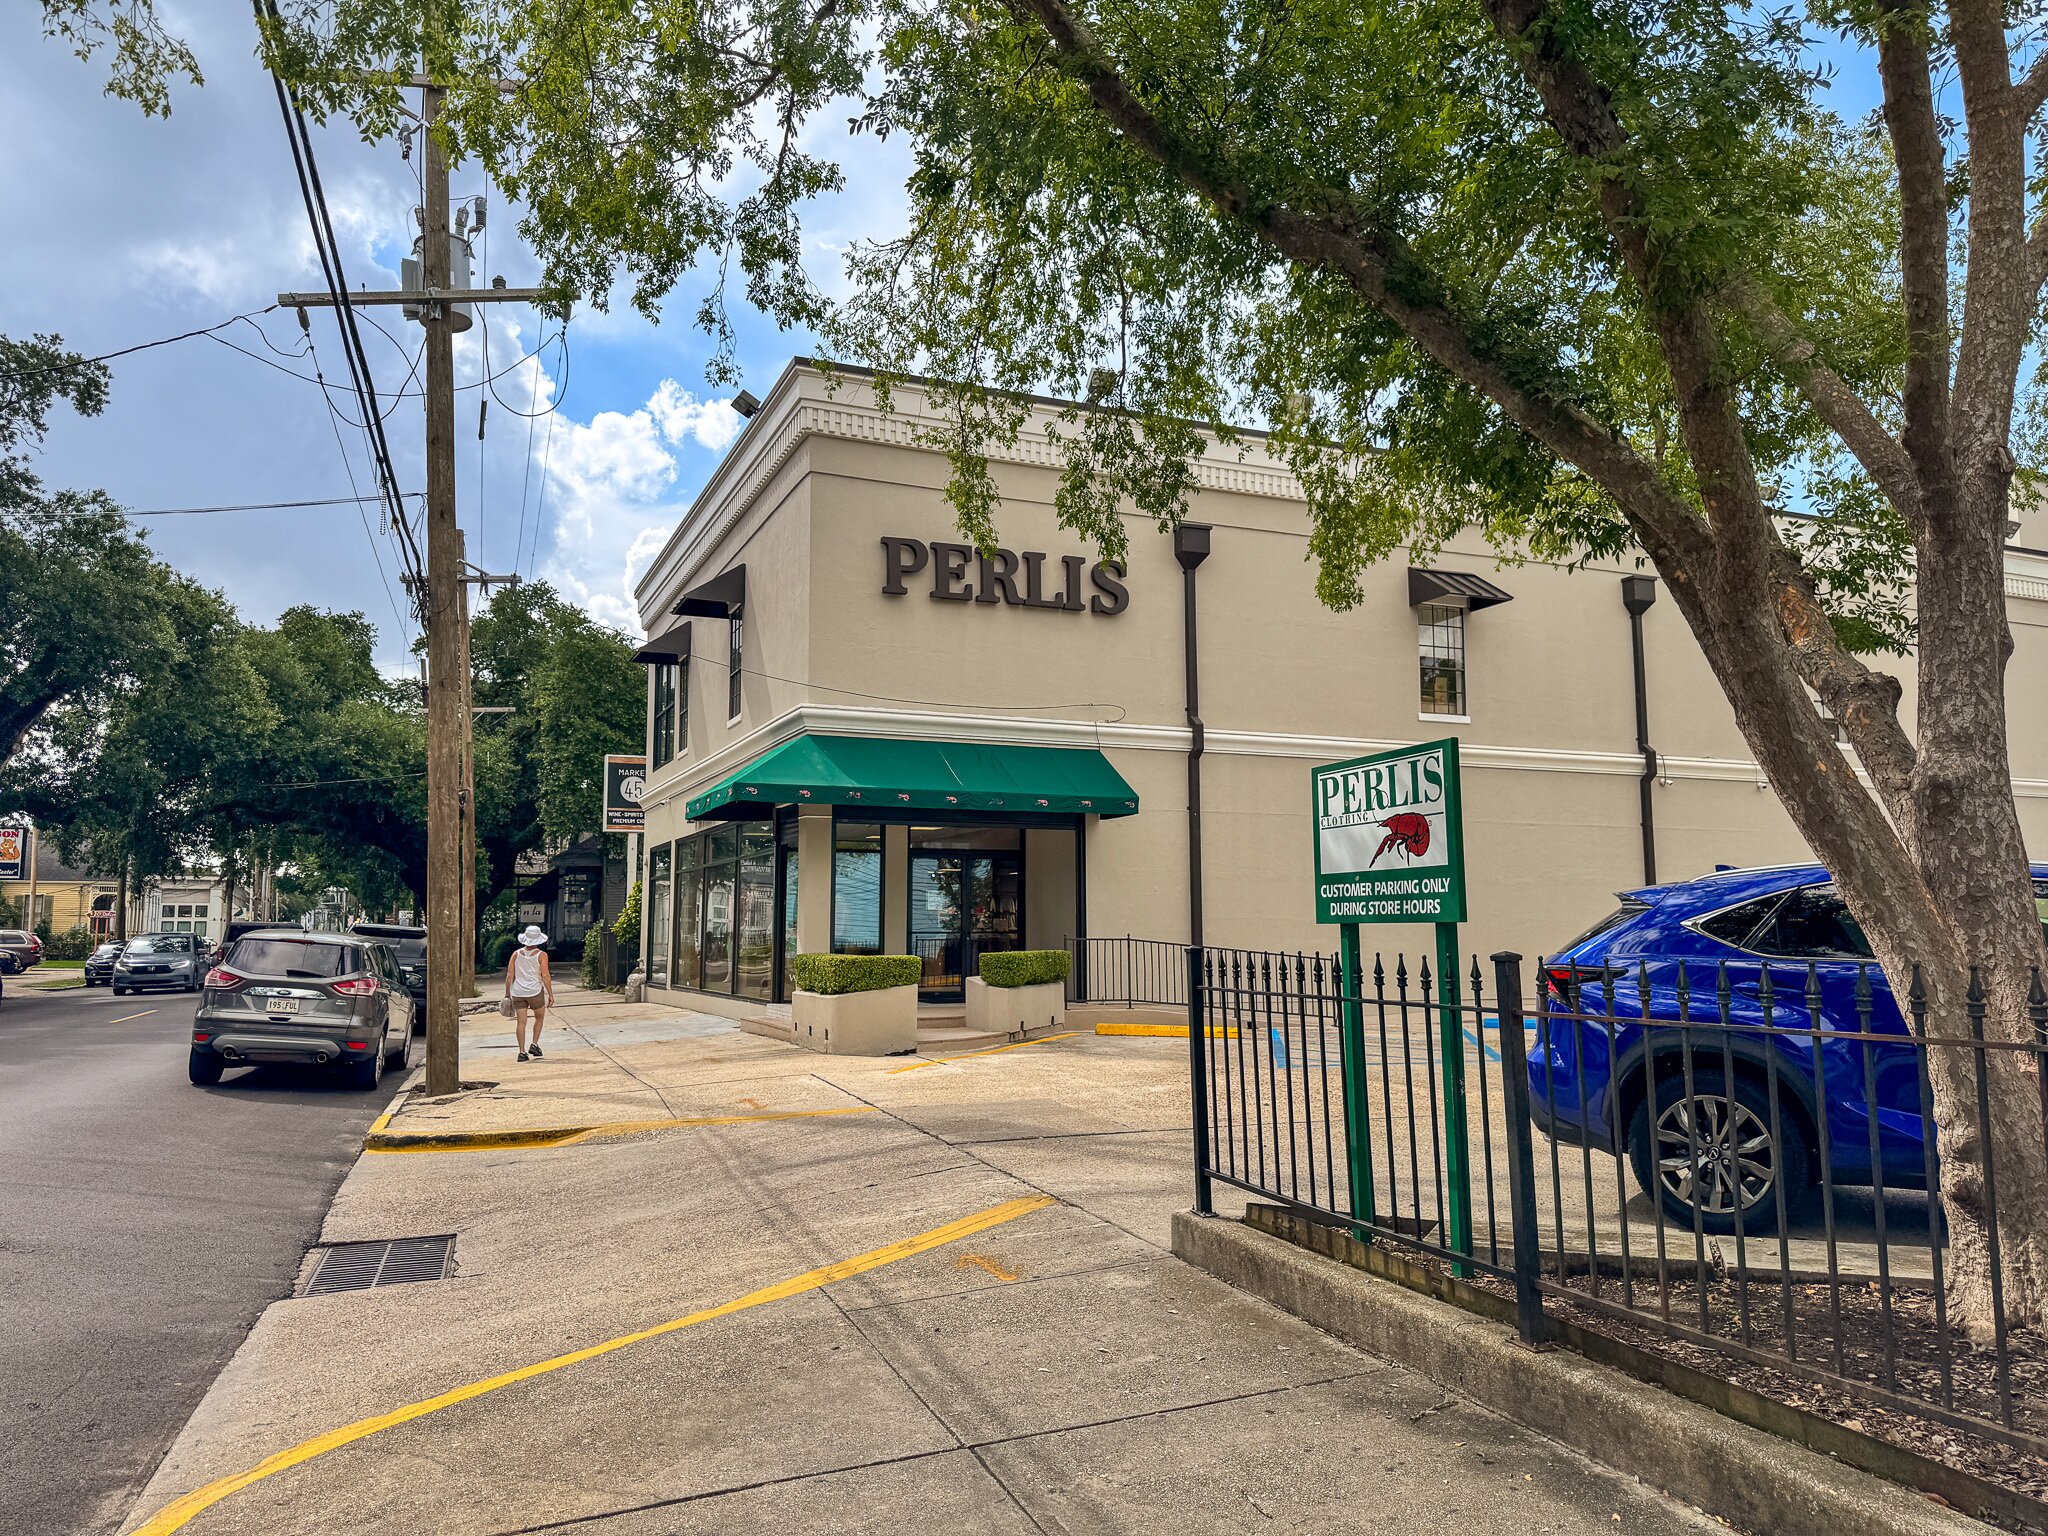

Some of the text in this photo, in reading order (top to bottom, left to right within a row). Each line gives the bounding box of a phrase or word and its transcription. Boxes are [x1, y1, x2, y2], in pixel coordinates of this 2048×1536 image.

[880, 536, 1130, 616] PERLIS
[619, 769, 646, 777] MARKE
[625, 781, 642, 798] 45
[1320, 755, 1443, 819] PERLIS
[1321, 811, 1369, 828] CLOTHING
[0, 830, 19, 838] ON
[1321, 877, 1451, 899] CUSTOMER PARKING ONLY
[1330, 898, 1441, 916] DURING STORE HOURS
[269, 1001, 297, 1010] 195 FUL
